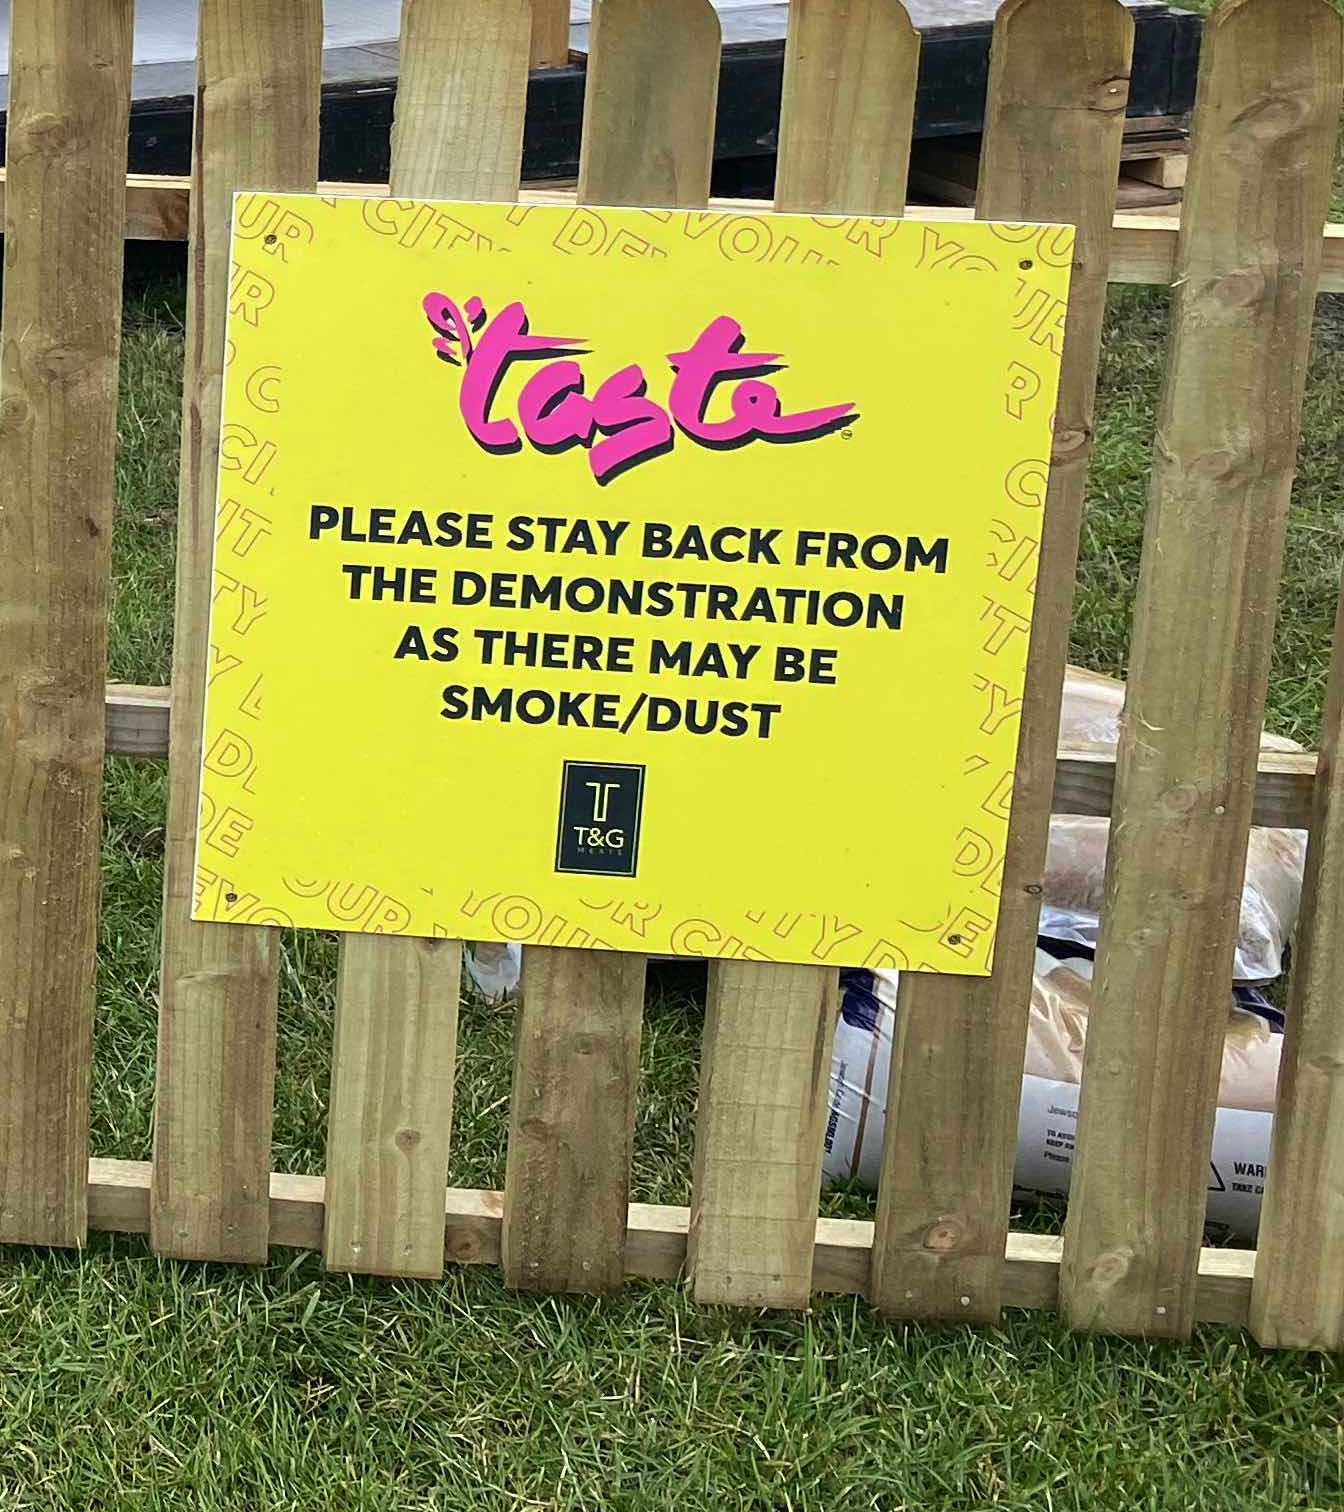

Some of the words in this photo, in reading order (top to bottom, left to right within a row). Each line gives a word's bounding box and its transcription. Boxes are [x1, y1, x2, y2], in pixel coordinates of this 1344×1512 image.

[459, 300, 860, 487] taste
[309, 504, 494, 550] PLEASE
[506, 515, 631, 556] STAY
[641, 522, 783, 565] BACK
[795, 530, 949, 574] FROM
[342, 564, 437, 604] THE
[451, 570, 904, 630] DEMONSTRATION
[393, 625, 459, 662] AS
[473, 629, 635, 673] THERE
[649, 639, 762, 680] MAY
[773, 646, 838, 685] BE
[440, 684, 782, 739] SMOKE/DUST
[573, 826, 625, 849] T&G
[1233, 1161, 1267, 1178] WAR
